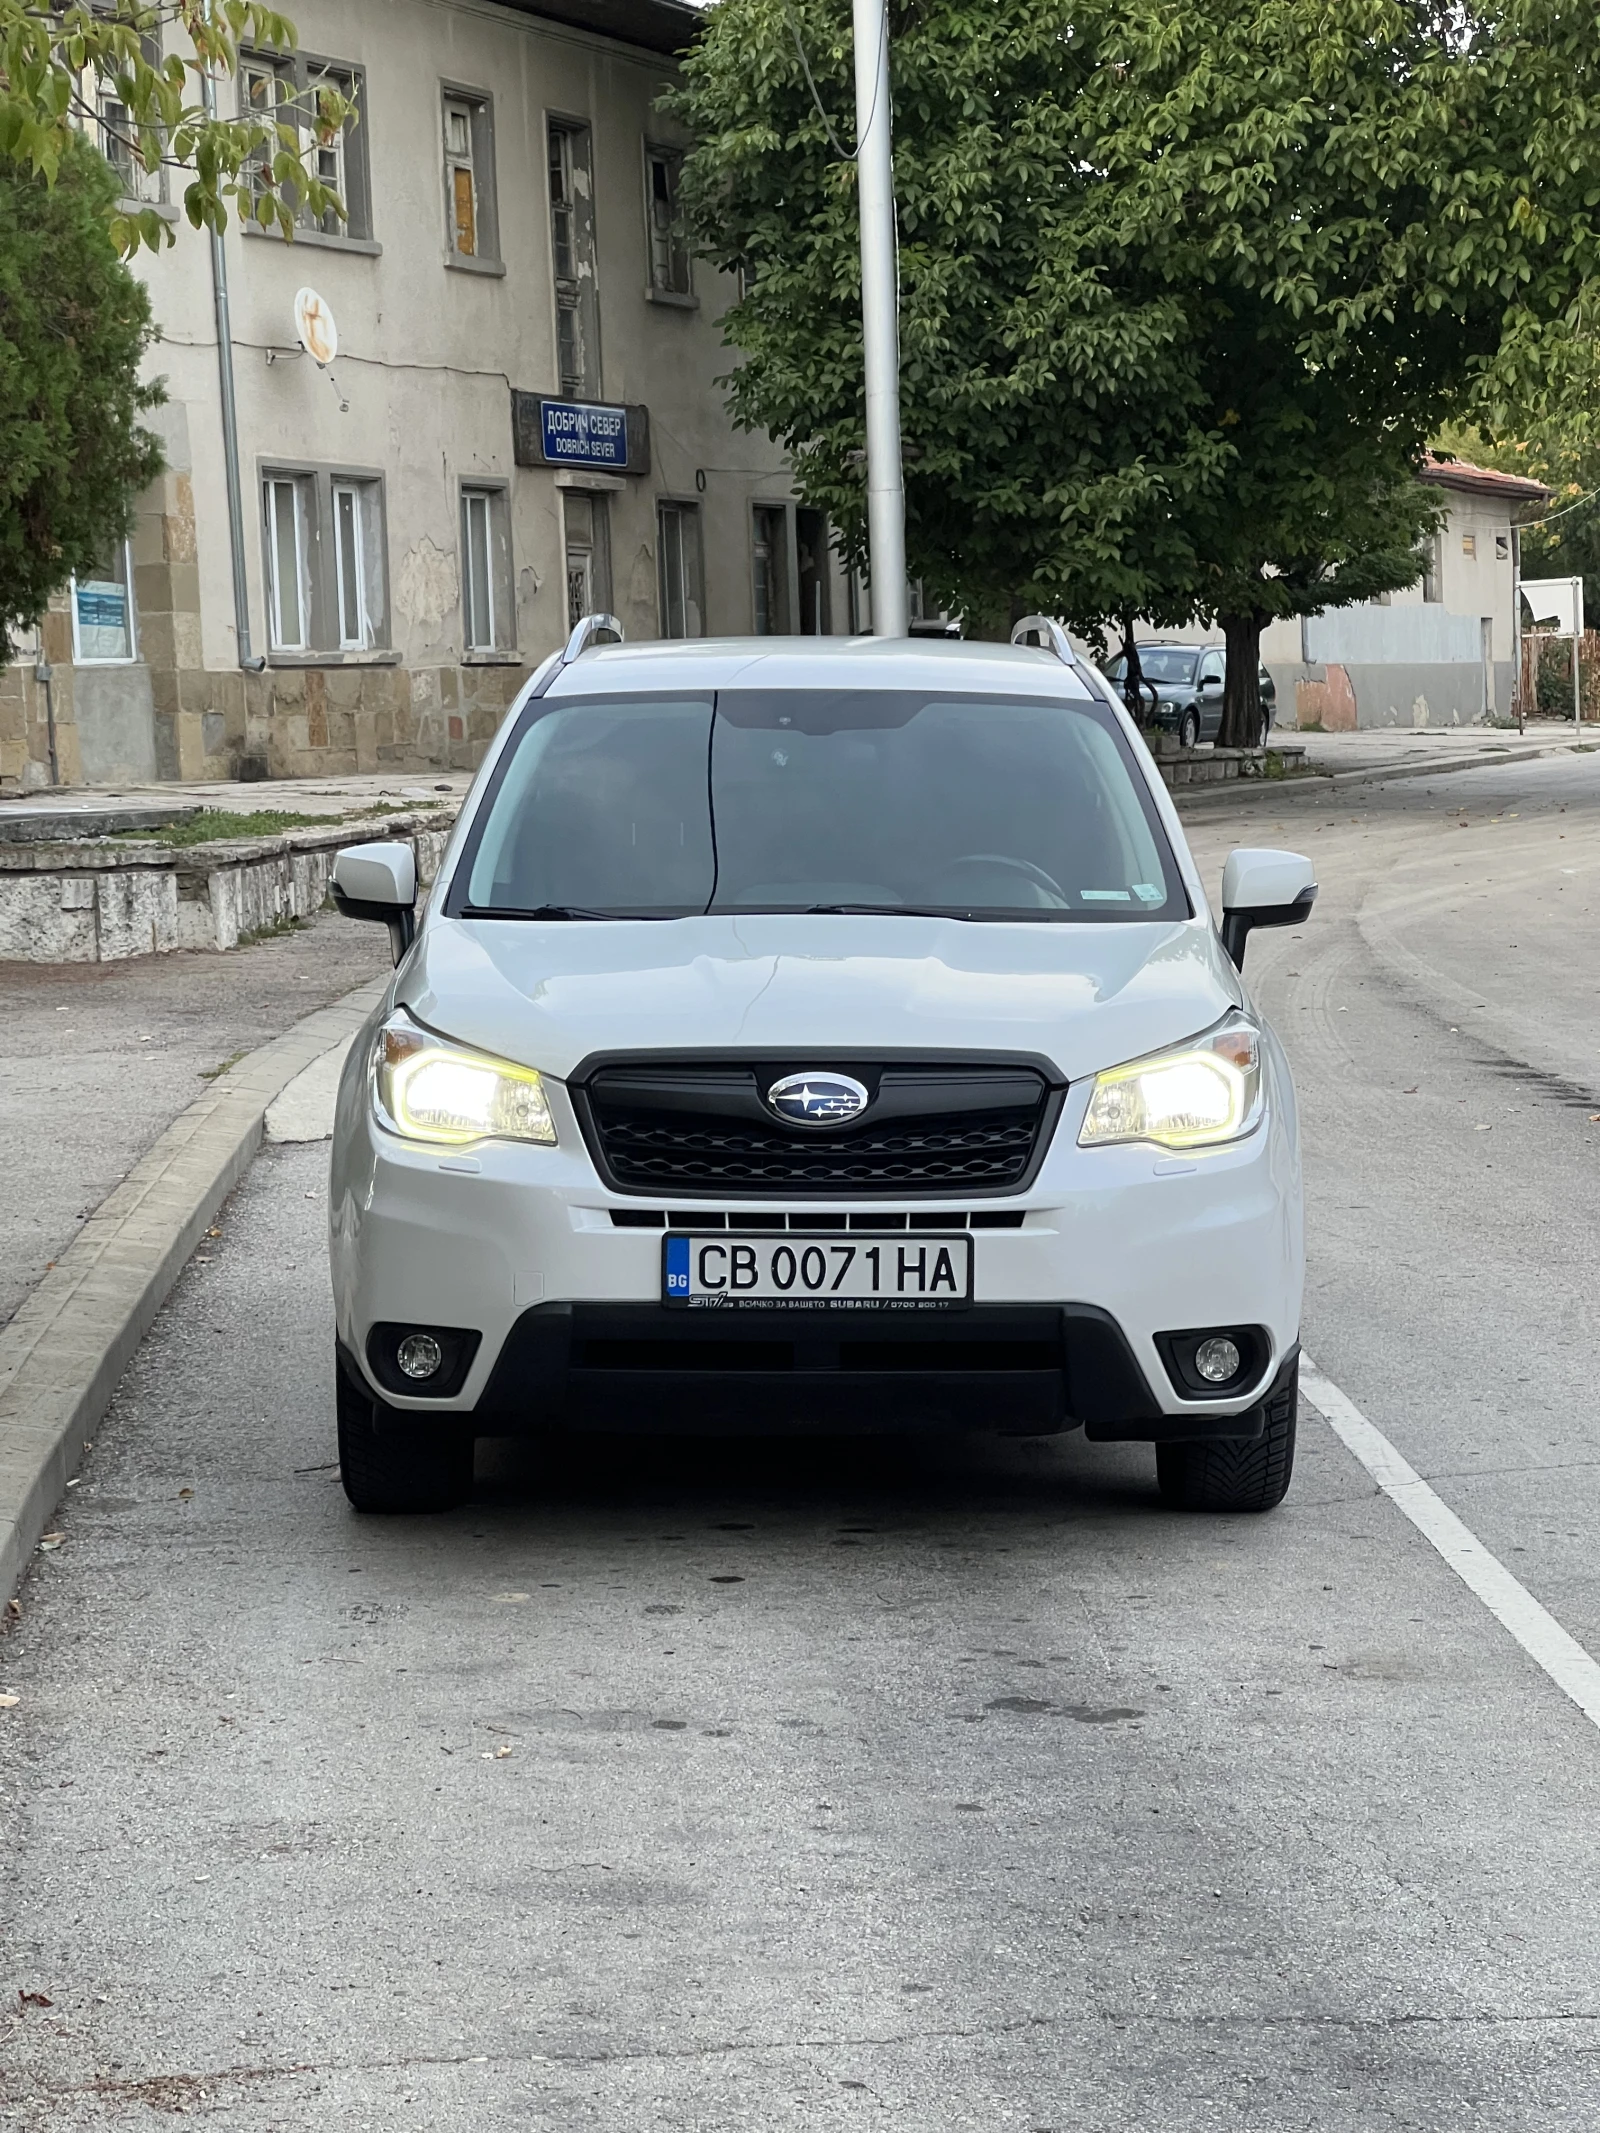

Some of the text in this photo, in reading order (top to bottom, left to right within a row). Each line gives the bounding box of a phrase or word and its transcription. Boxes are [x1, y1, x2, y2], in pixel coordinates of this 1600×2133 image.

[547, 410, 621, 437] ДОБРИЧ СЕВЕР
[555, 437, 615, 458] DOBRICH SEVER
[698, 1244, 958, 1292] CB 0071 HA
[667, 1273, 688, 1288] BG
[738, 1300, 774, 1308] ВСИЧКО
[775, 1300, 787, 1308] ЗА
[788, 1300, 826, 1308] ВАШЕТО
[829, 1299, 880, 1309] SUBARU
